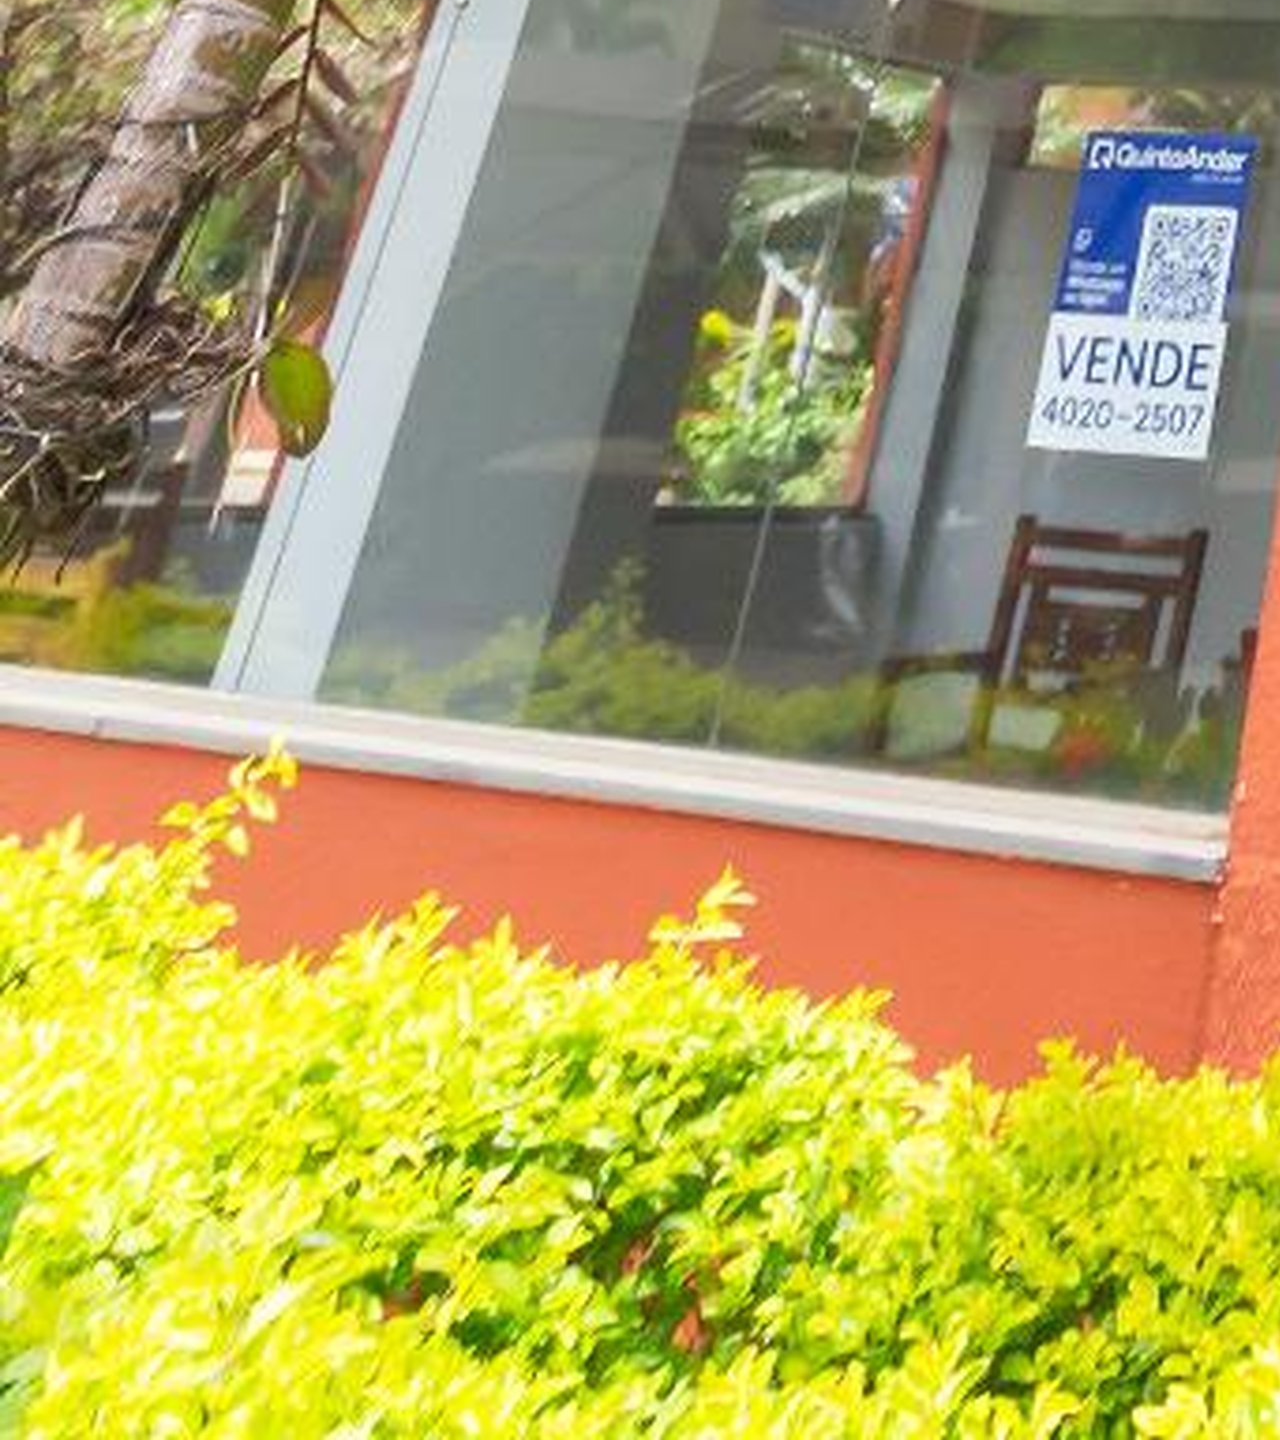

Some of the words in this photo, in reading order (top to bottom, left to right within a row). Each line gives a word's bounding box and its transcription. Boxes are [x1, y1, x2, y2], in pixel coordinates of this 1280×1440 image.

[1115, 141, 1248, 171] QuintoAndar
[1056, 334, 1215, 391] VENDE
[1041, 395, 1205, 437] 4020-2507
